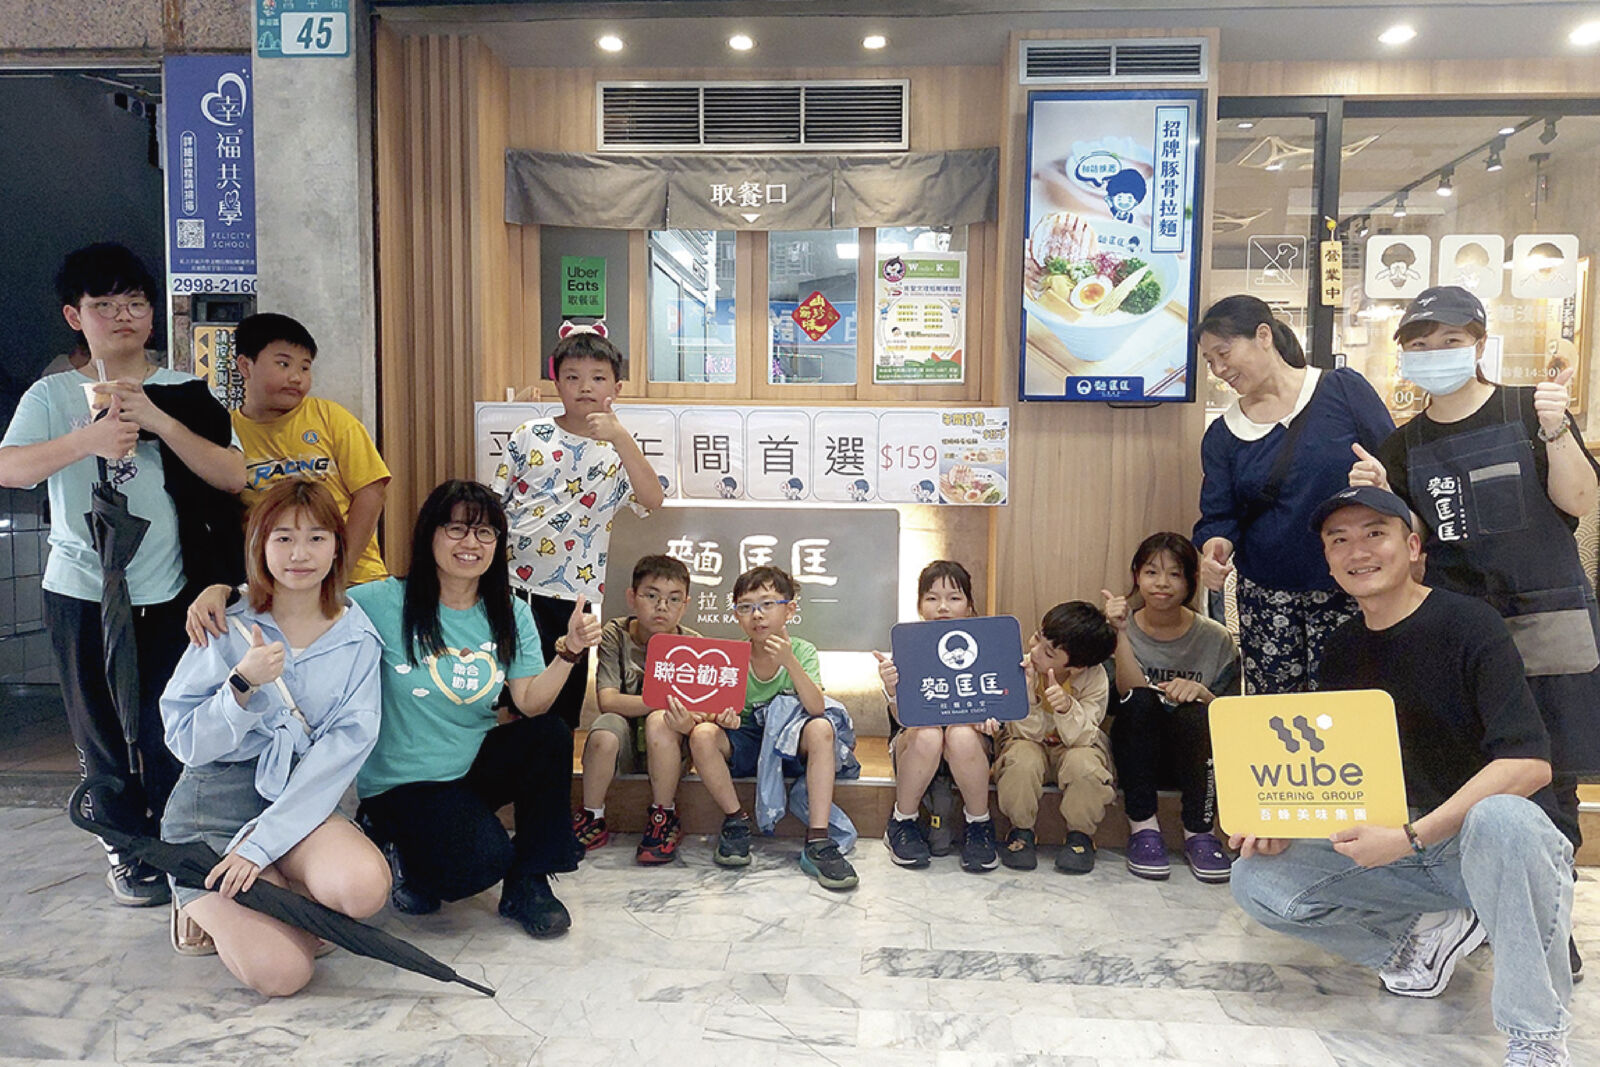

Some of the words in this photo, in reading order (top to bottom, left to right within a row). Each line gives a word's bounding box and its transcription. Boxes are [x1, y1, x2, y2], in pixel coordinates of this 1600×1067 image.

[297, 17, 333, 49] 45
[1160, 120, 1181, 238] 招牌豚骨拉麵
[709, 181, 787, 207] 取餐口
[211, 232, 251, 240] FELICITY
[213, 241, 250, 249] SCHOOL
[567, 266, 600, 278] Uber
[567, 279, 599, 291] Eats
[880, 442, 938, 471] $159
[1427, 476, 1460, 541] 麵匡匡
[665, 535, 838, 586] 麵匡匡
[697, 614, 719, 624] MKK
[654, 661, 739, 687] 聯合勸募
[920, 672, 1003, 701] 麵匡匡
[1250, 756, 1363, 787] wube
[1257, 792, 1314, 801] CATERING
[1322, 791, 1364, 800] GROUP
